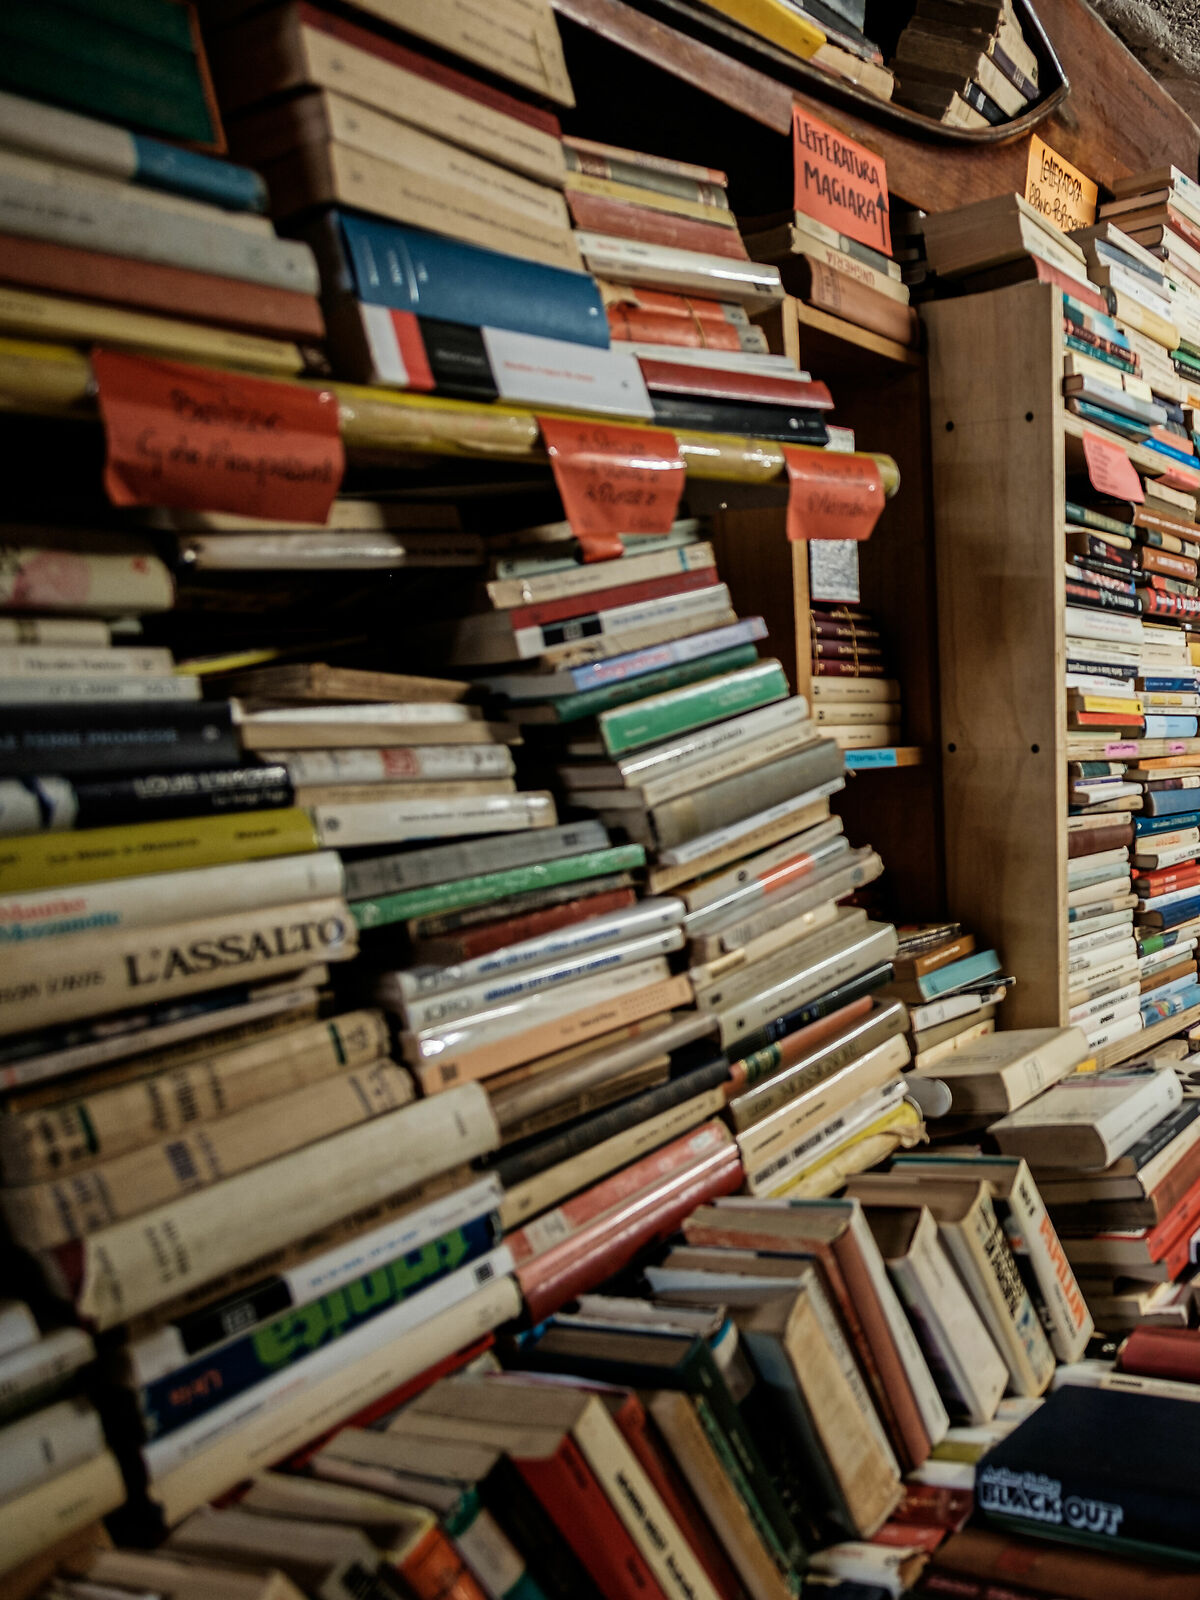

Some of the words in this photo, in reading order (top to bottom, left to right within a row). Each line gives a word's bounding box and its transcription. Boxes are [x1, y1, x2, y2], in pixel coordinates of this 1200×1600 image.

[796, 115, 880, 188] LETTERATURA
[804, 160, 877, 225] MAGIARA
[124, 916, 345, 988] L'ASSALTO
[980, 1481, 1063, 1524] BLACK
[1064, 1496, 1124, 1536] OUT
